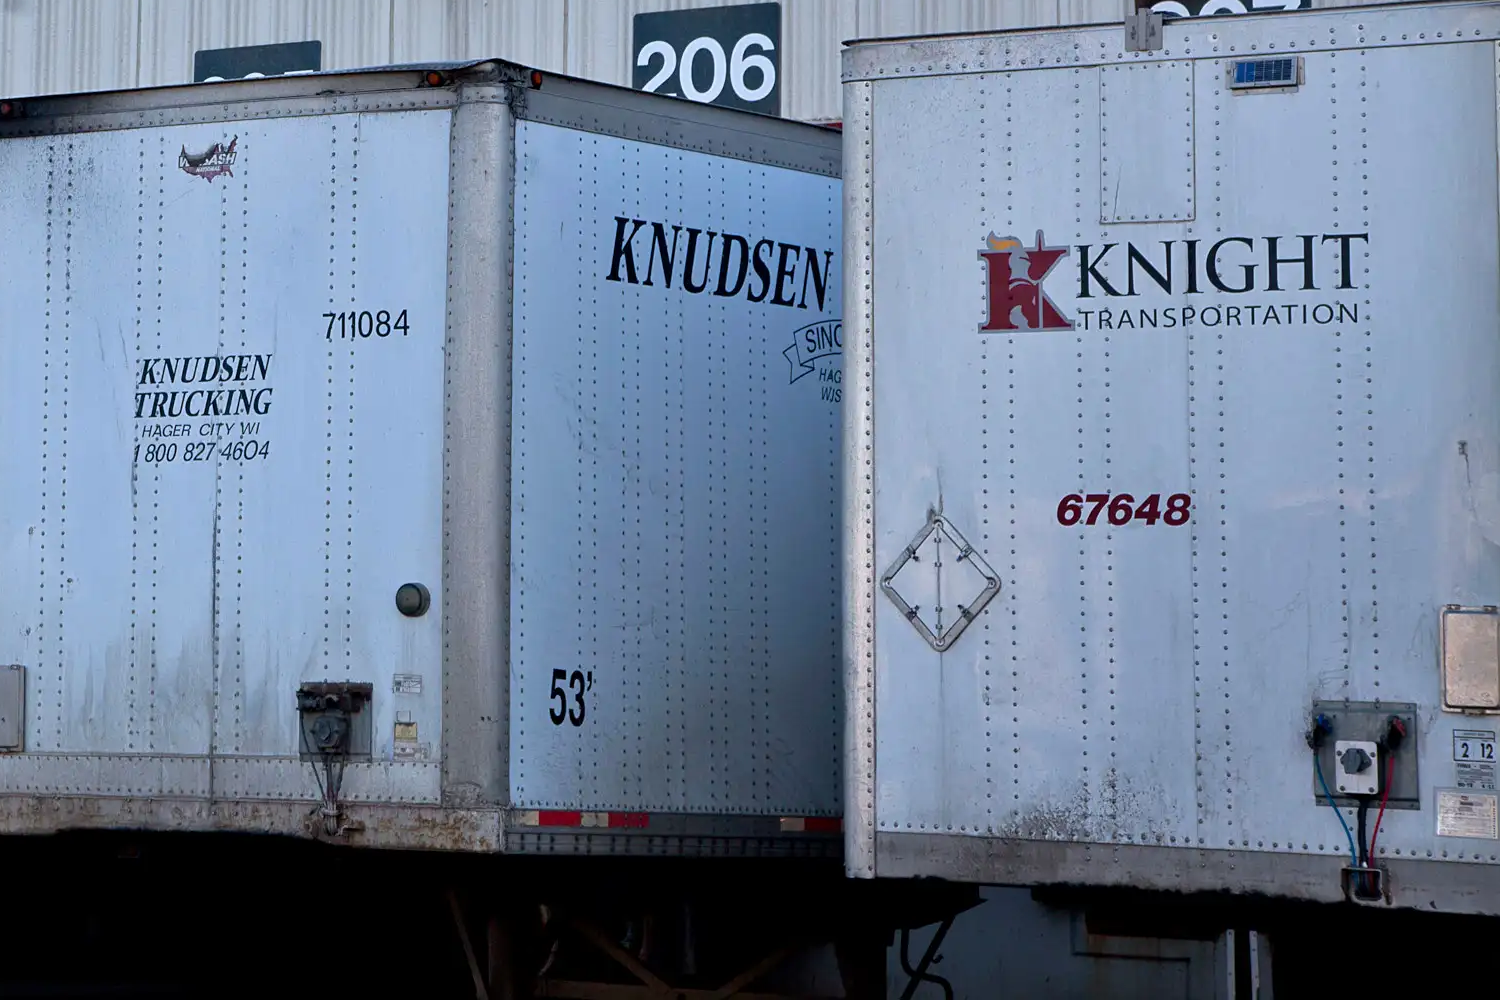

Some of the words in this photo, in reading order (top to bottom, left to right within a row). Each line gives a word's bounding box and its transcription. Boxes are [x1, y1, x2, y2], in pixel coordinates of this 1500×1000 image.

[637, 33, 776, 104] 206
[606, 216, 834, 312] KNUDSEN
[1076, 232, 1369, 299] KNIGHT
[322, 309, 410, 339] 711084
[1079, 303, 1359, 331] TRANSPORTATION
[805, 323, 842, 353] SINC
[139, 354, 273, 385] KNUDSEN
[819, 367, 842, 383] HAG
[134, 388, 273, 418] TRUCKING
[821, 386, 842, 402] WIS
[142, 424, 191, 437] HAGER
[199, 423, 235, 436] CITY
[240, 422, 260, 434] WI
[134, 445, 140, 462] 1
[145, 443, 177, 462] 800
[183, 443, 216, 462] 827
[1057, 494, 1191, 526] 67648
[549, 668, 592, 727] 53'
[1461, 743, 1469, 758] 2
[1481, 743, 1493, 759] 12
